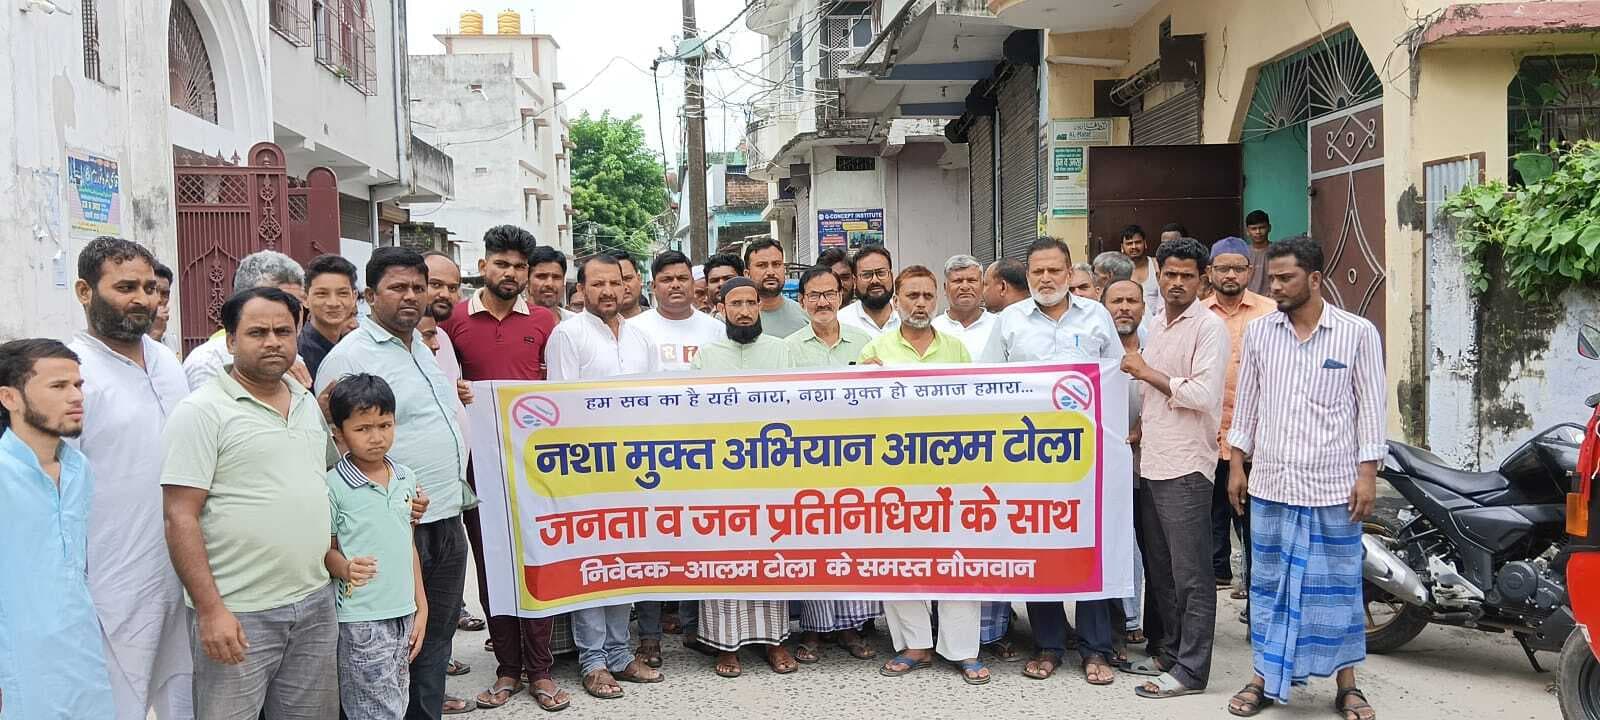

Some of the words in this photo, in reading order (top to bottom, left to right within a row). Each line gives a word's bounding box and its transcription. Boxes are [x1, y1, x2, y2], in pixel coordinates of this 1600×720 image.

[585, 397, 612, 410] हम
[619, 395, 651, 408] सब
[658, 394, 682, 407] का
[687, 387, 702, 407] है
[706, 386, 742, 407] यही
[747, 390, 791, 405] नारा,
[798, 388, 836, 403] नशा
[842, 386, 883, 405] मुक्त
[889, 381, 909, 400] हो
[914, 383, 967, 397] समाज
[974, 381, 1033, 397] हमारा...
[534, 441, 617, 475] नशा
[623, 438, 716, 490] मुक्त
[722, 422, 876, 469] अभियान
[881, 429, 996, 466] आलम
[1002, 415, 1084, 463] टोला
[535, 506, 649, 546] जनता
[655, 505, 684, 537] व
[688, 504, 760, 536] जन
[765, 485, 954, 543] प्रतिनिधियों
[960, 484, 1000, 533] के
[1006, 498, 1081, 534] साथ
[763, 552, 817, 578] टोला
[825, 551, 853, 577] के
[856, 558, 933, 578] समस्त
[936, 549, 1036, 578] नौजवान
